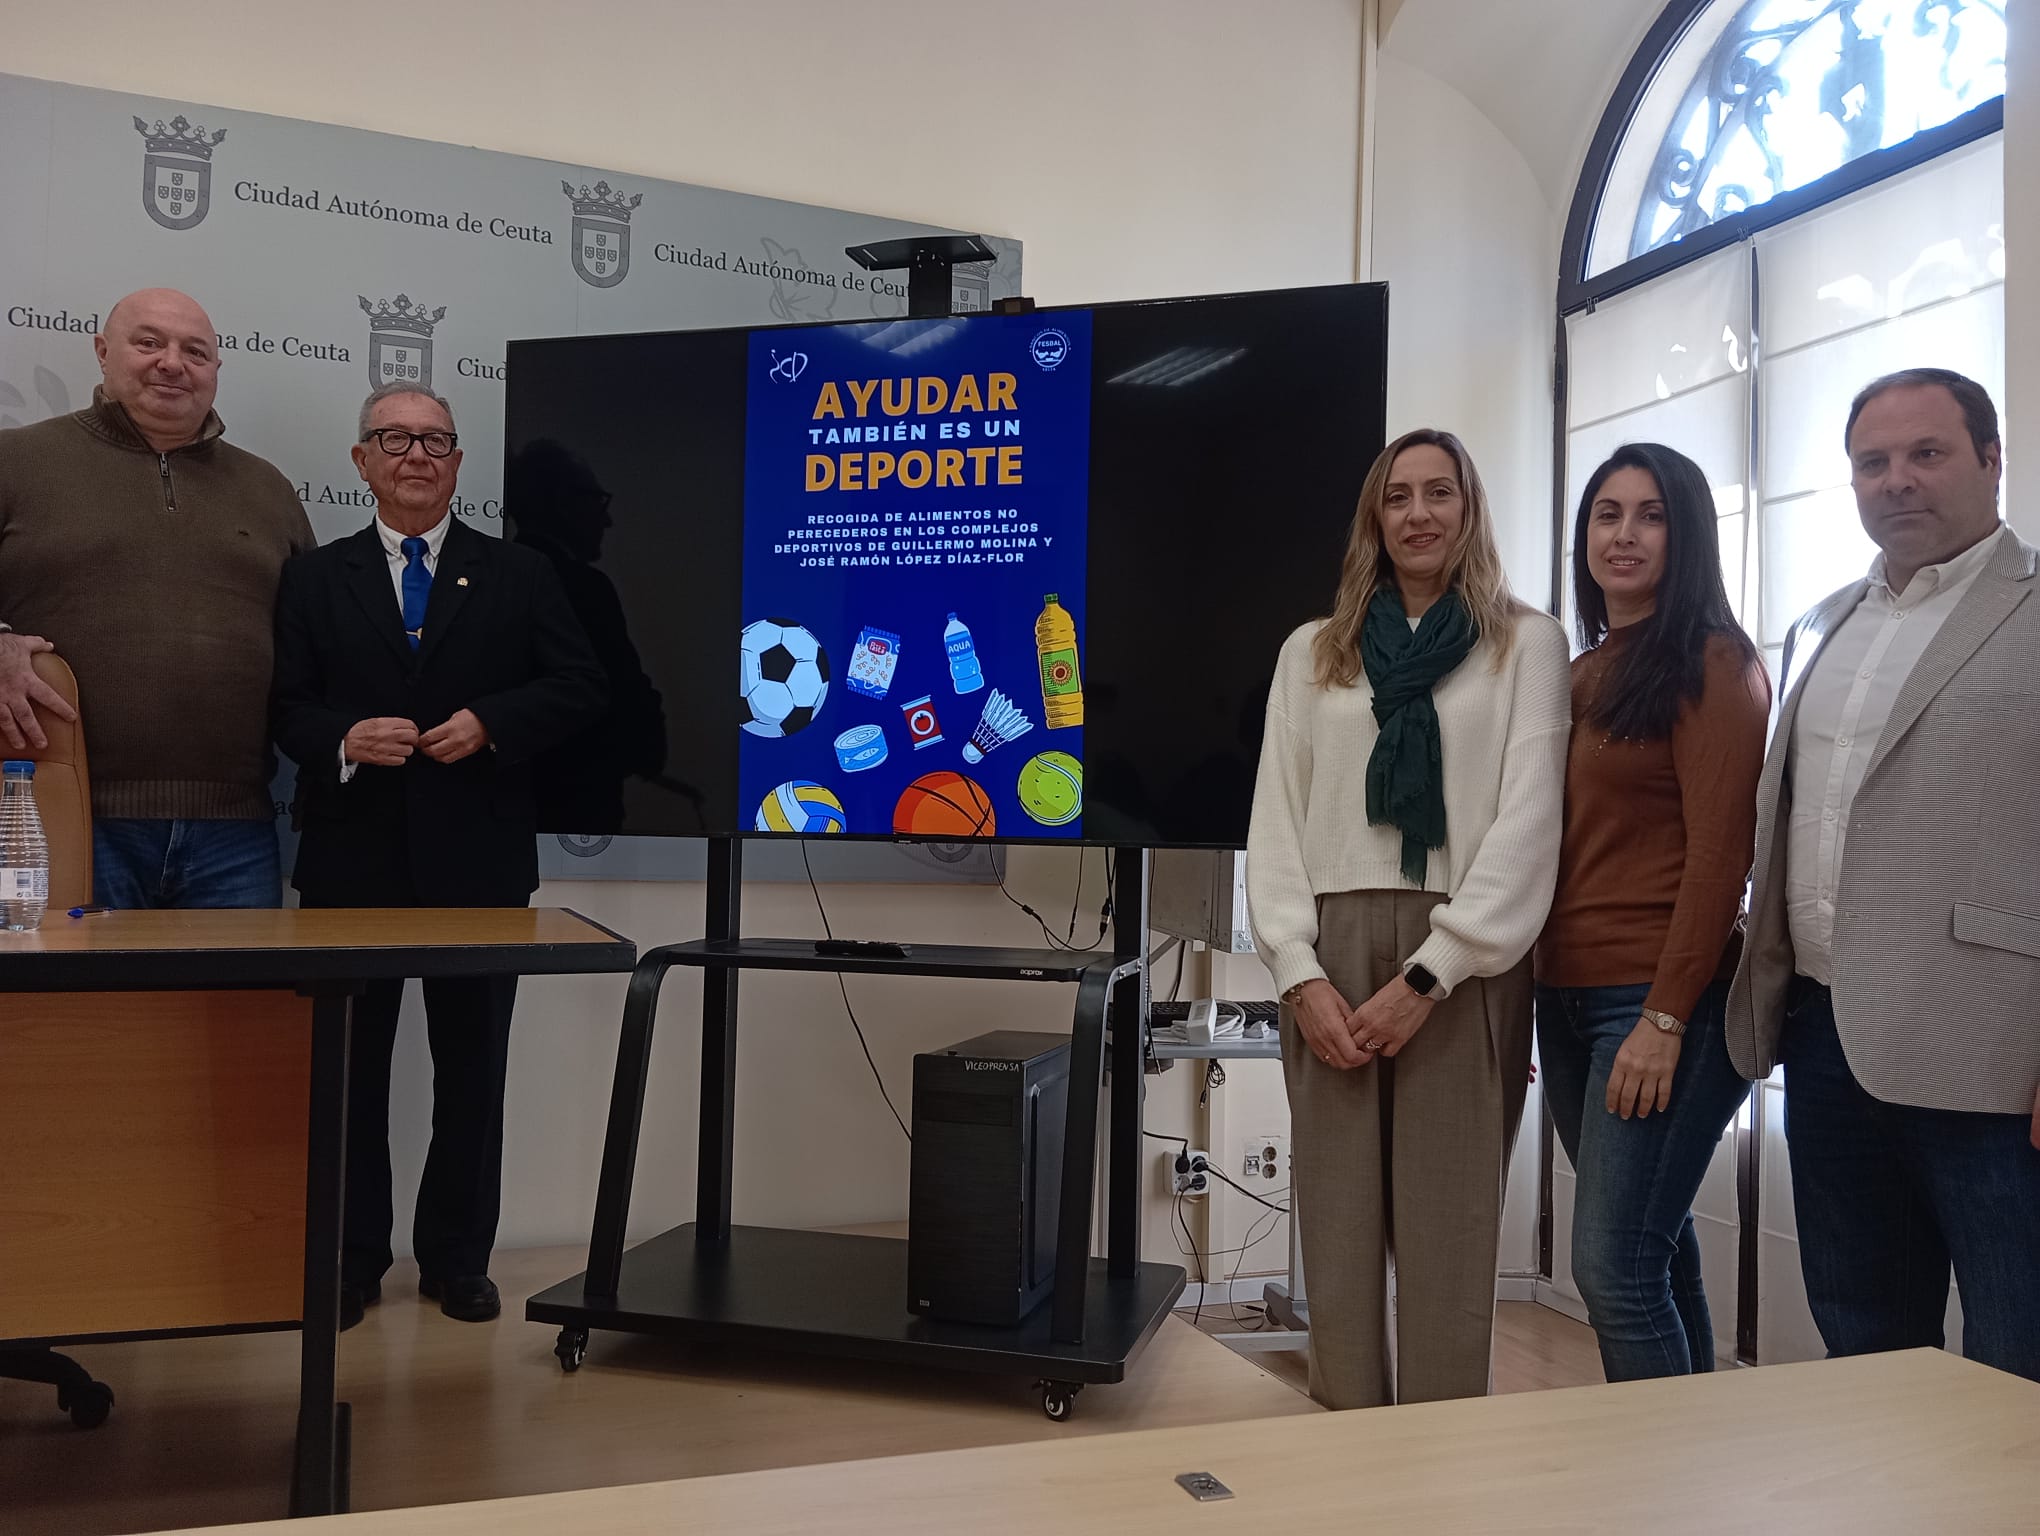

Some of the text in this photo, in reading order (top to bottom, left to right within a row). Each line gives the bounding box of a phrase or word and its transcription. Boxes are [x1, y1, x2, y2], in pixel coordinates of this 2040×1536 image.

[234, 180, 554, 245] Ciudad Autónoma de Ceuta
[653, 243, 910, 299] Ciudad Autónoma de Ceu
[7, 306, 99, 335] Ciudad
[245, 333, 276, 355] de
[281, 336, 352, 363] Ceuta
[812, 372, 1018, 420] AYUDAR
[808, 419, 1020, 446] TAMBIÉN ES UN
[805, 446, 1023, 493] DEPORTE
[807, 508, 1018, 525] RECOGIDA DE ALIMENTOS NO
[774, 536, 1053, 554] DEPORTIVOS DE GUILLERMO MOLINA Y
[787, 522, 1039, 540] PERECEDEROS EN LOS COMPLEJOS
[799, 551, 1024, 568] JOSÉ RAMÓN LÓPEZ DÍAZ-FLOR
[947, 639, 972, 655] AQUA
